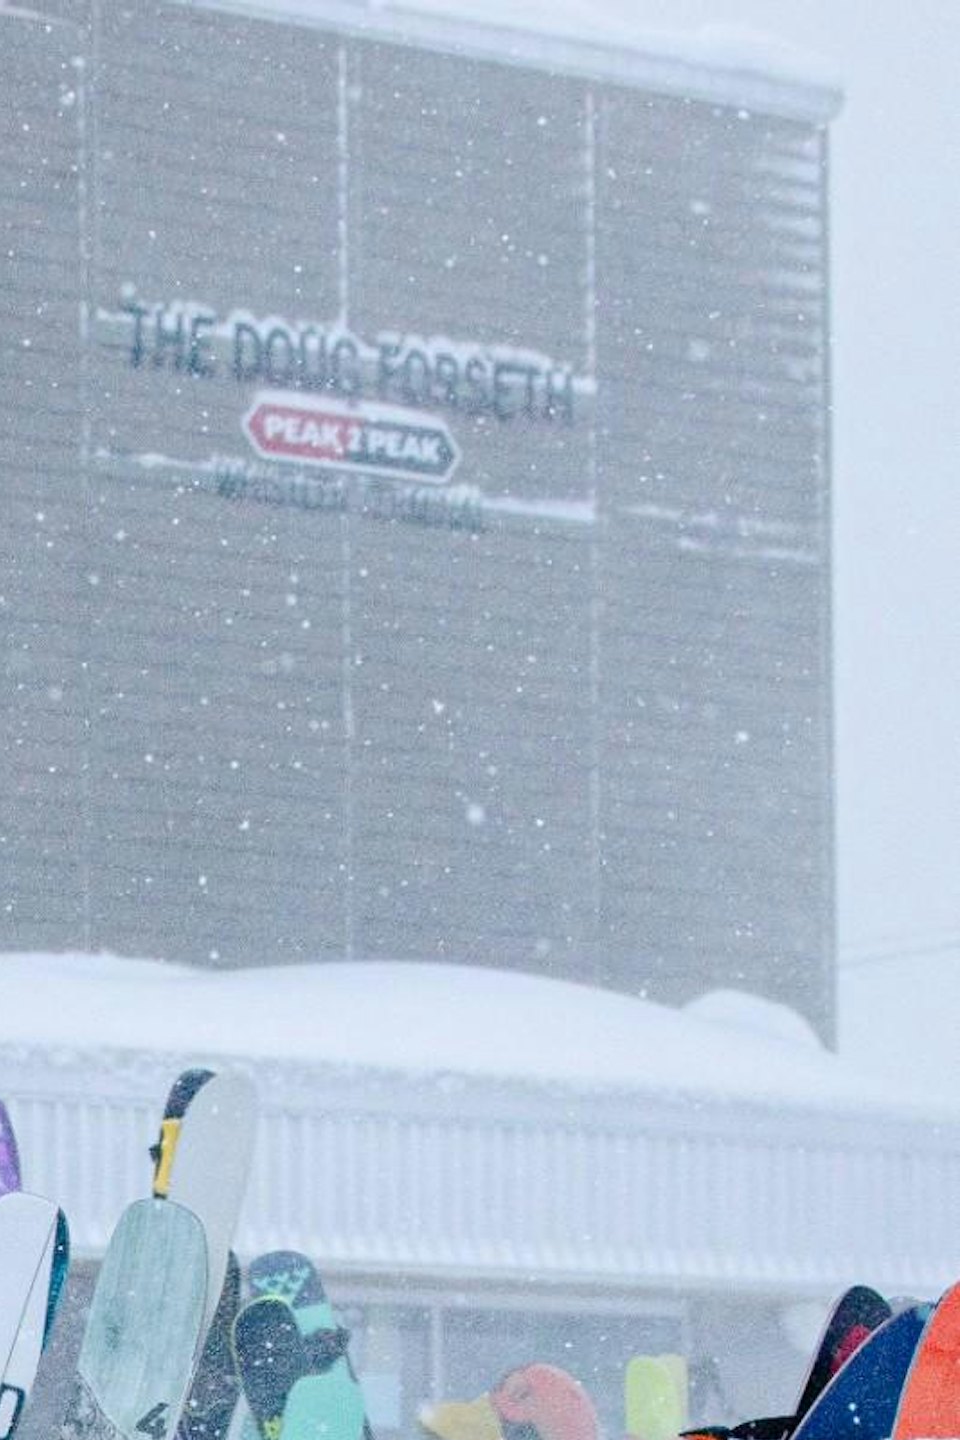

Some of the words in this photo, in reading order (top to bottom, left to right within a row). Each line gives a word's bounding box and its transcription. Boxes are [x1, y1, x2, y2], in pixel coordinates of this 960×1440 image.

[123, 302, 217, 376] THE
[264, 415, 340, 449] PEAK
[366, 429, 441, 464] PEAK
